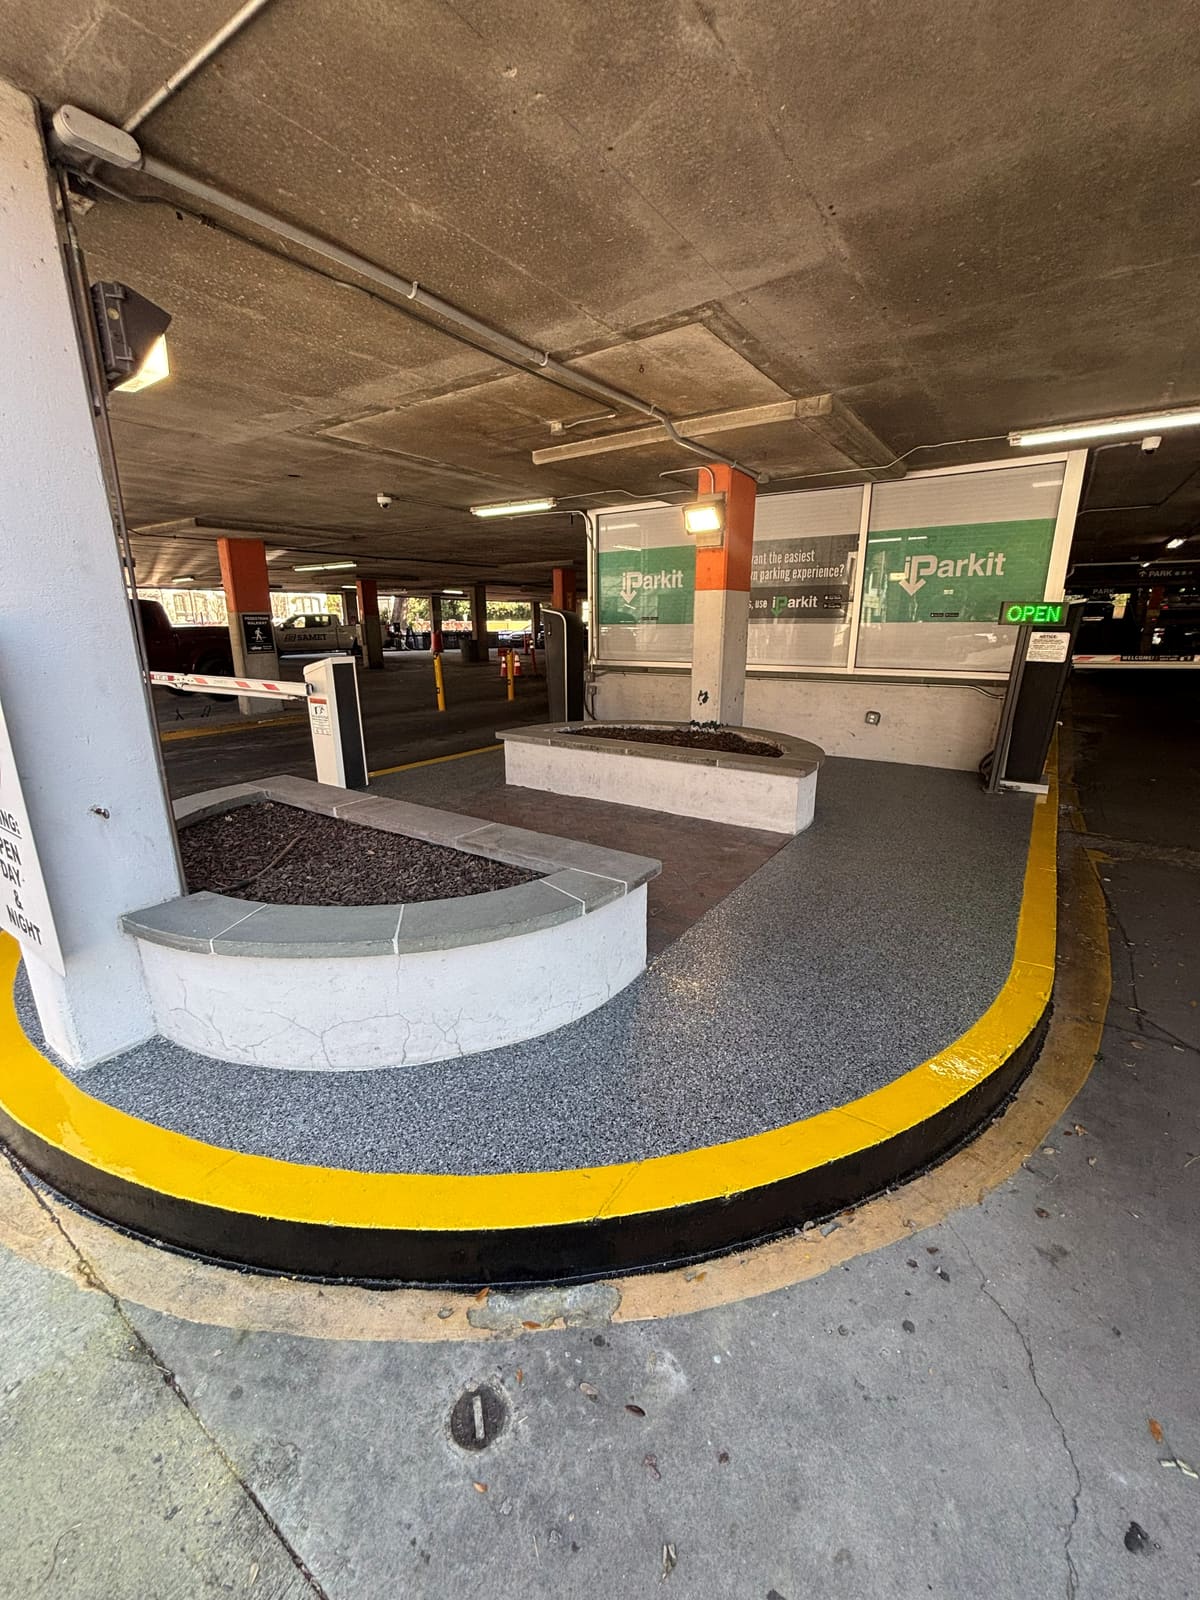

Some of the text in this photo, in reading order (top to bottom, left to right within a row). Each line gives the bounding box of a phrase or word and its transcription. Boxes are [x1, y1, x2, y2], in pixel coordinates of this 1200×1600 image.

[769, 551, 782, 562] the
[784, 549, 815, 564] easiest
[760, 566, 791, 582] parking
[792, 564, 845, 581] experience?
[899, 552, 1006, 596] iParkit
[755, 599, 768, 609] use
[1007, 605, 1062, 622] OPEN
[297, 633, 328, 641] SAMET
[0, 858, 22, 888] DAY
[13, 888, 24, 911] &
[6, 904, 42, 945] NIGHT
